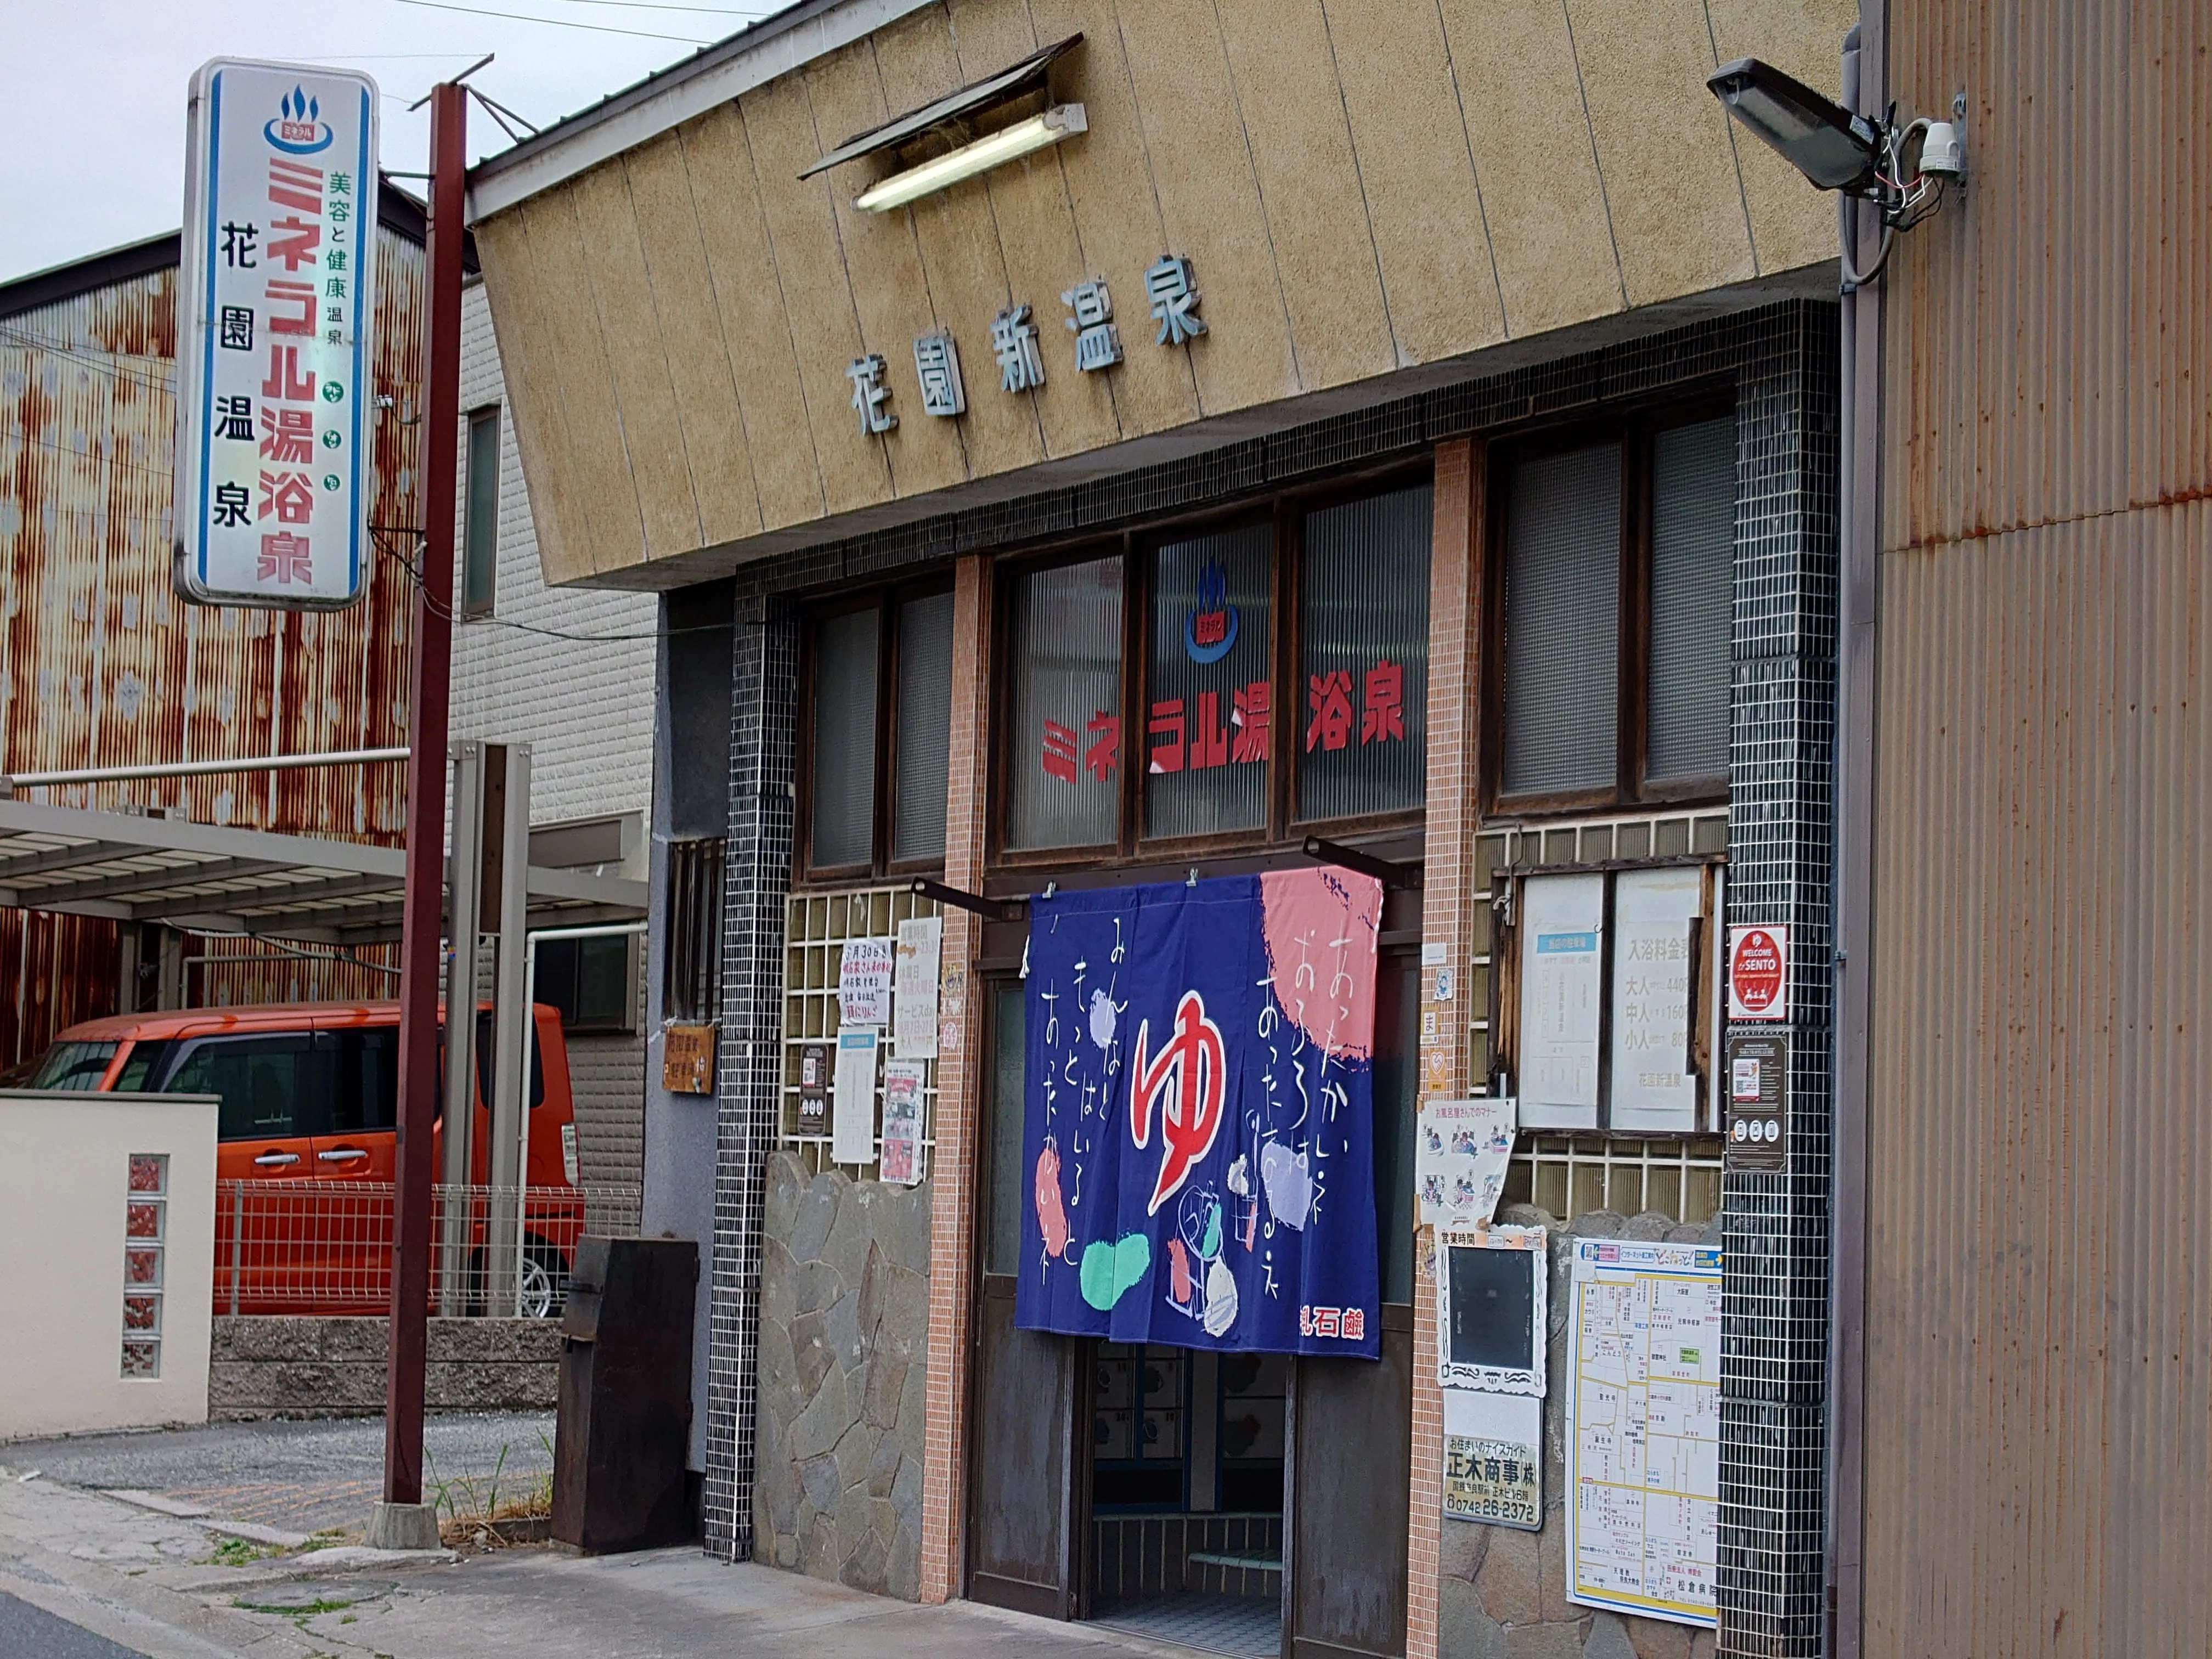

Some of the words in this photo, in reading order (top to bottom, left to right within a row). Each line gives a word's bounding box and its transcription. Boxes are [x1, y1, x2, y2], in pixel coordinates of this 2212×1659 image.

[284, 125, 312, 137] ミネラル
[845, 254, 1207, 436] 花園新温泉
[212, 221, 258, 528] 花園温泉
[257, 157, 324, 584] ミネラル湯浴泉
[1742, 948, 1773, 957] WELCOME
[1745, 959, 1776, 971] SENTO
[1626, 975, 1650, 996] 大人
[1626, 1002, 1650, 1024] 中人
[1625, 1029, 1650, 1051] 小人
[1131, 990, 1226, 1216] ゆ
[1436, 1107, 1497, 1119] お風呂屋さんでのマナー
[1441, 1232, 1475, 1245] 営業時間
[1450, 1437, 1527, 1458] お住まいのナイスガイド
[1456, 1500, 1481, 1514] 0742
[1483, 1498, 1534, 1522] 26-2372
